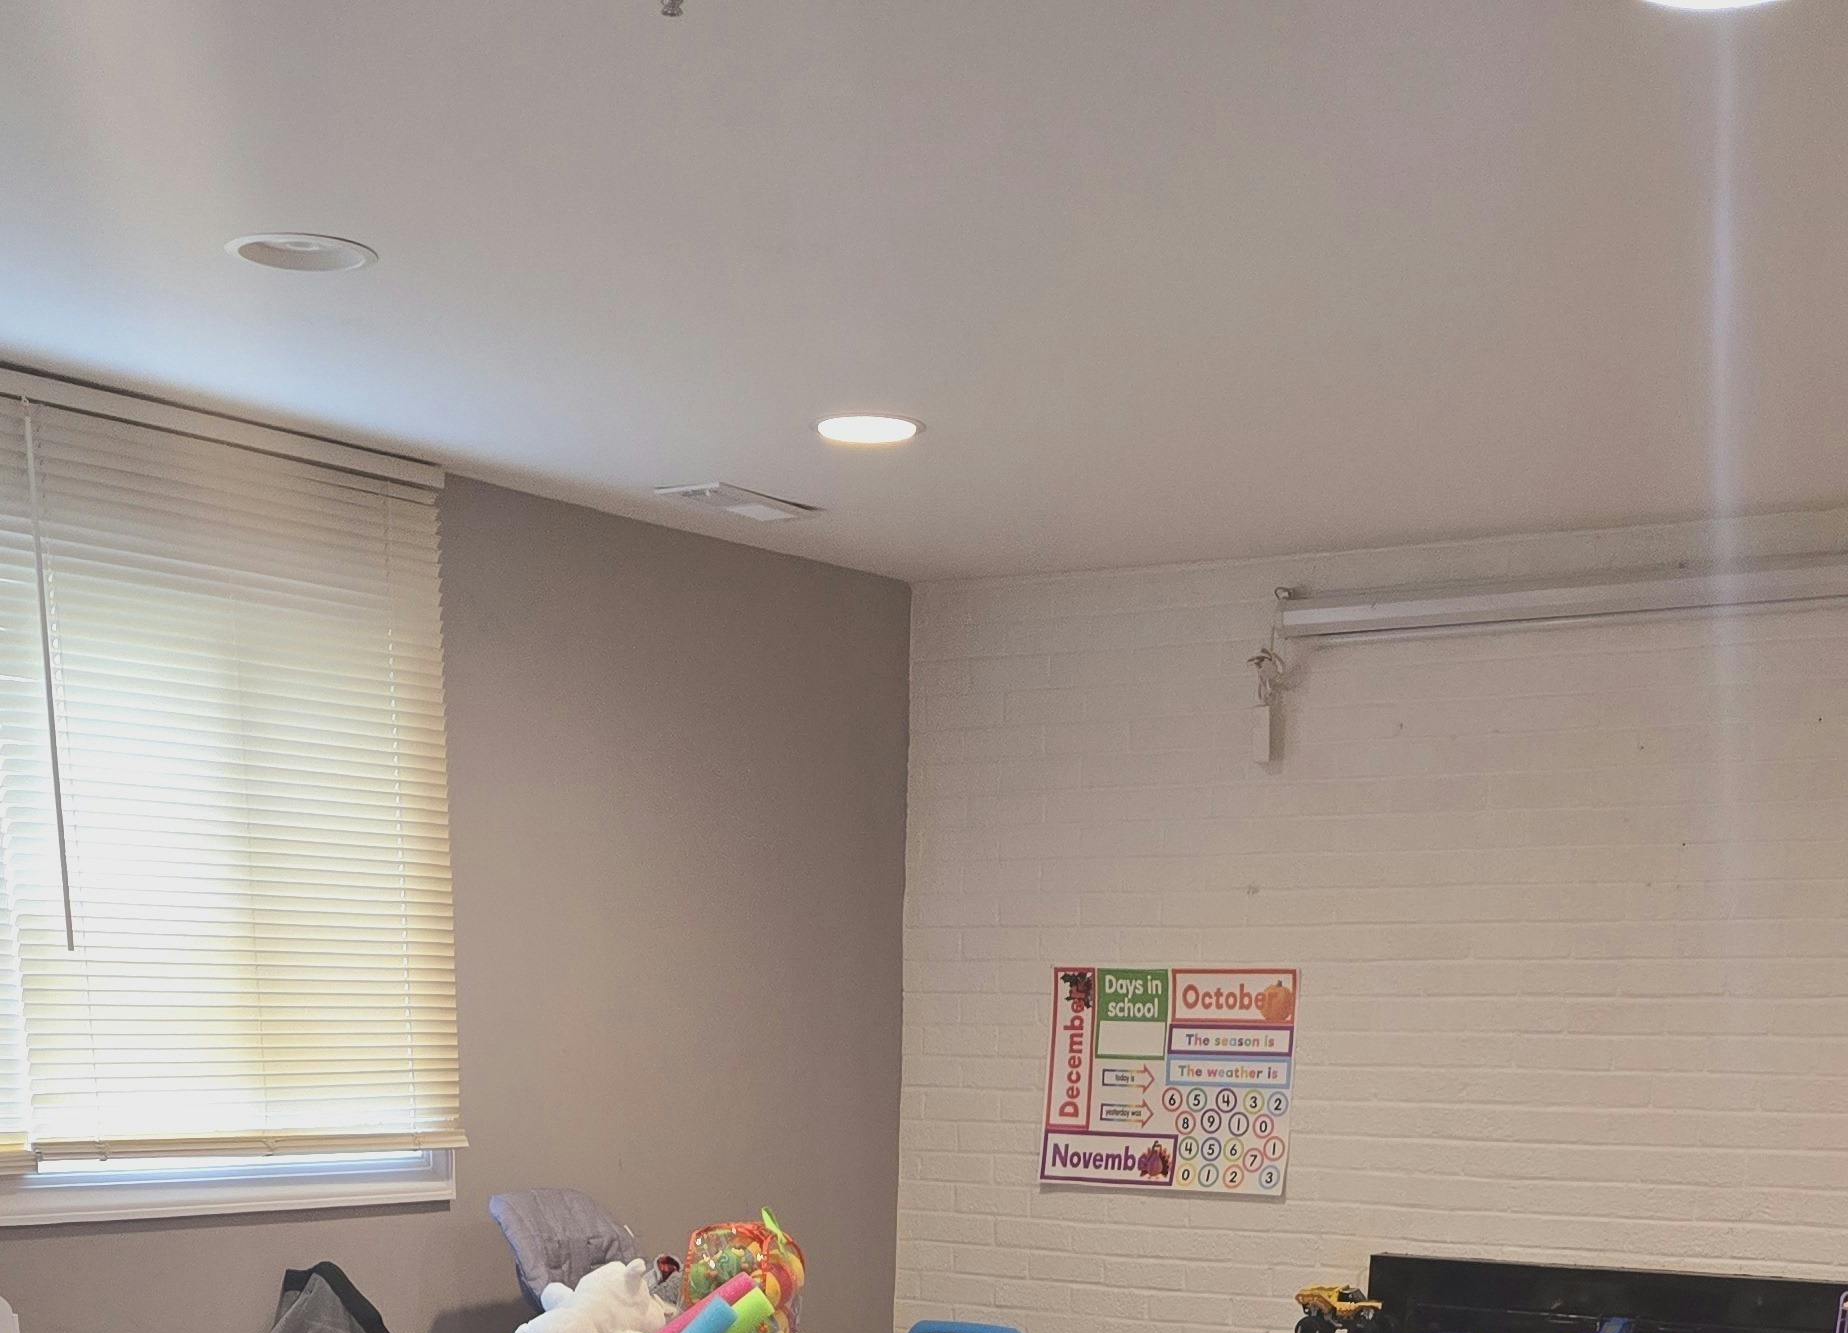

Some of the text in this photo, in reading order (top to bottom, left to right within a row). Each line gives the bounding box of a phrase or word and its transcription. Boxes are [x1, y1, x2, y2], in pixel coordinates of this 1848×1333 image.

[1104, 974, 1162, 995] Days in
[1107, 998, 1158, 1019] school
[1186, 1033, 1275, 1047] The season is
[1178, 1064, 1278, 1079] The weather is
[1169, 1093, 1282, 1111] 6 5 4 3 2
[1182, 1115, 1268, 1133] 8 9 1 0
[1051, 1143, 1153, 1172] Novemb
[1184, 1142, 1276, 1167] 4 5 6 7 1
[1182, 1169, 1273, 1184] 0 1 2 3
